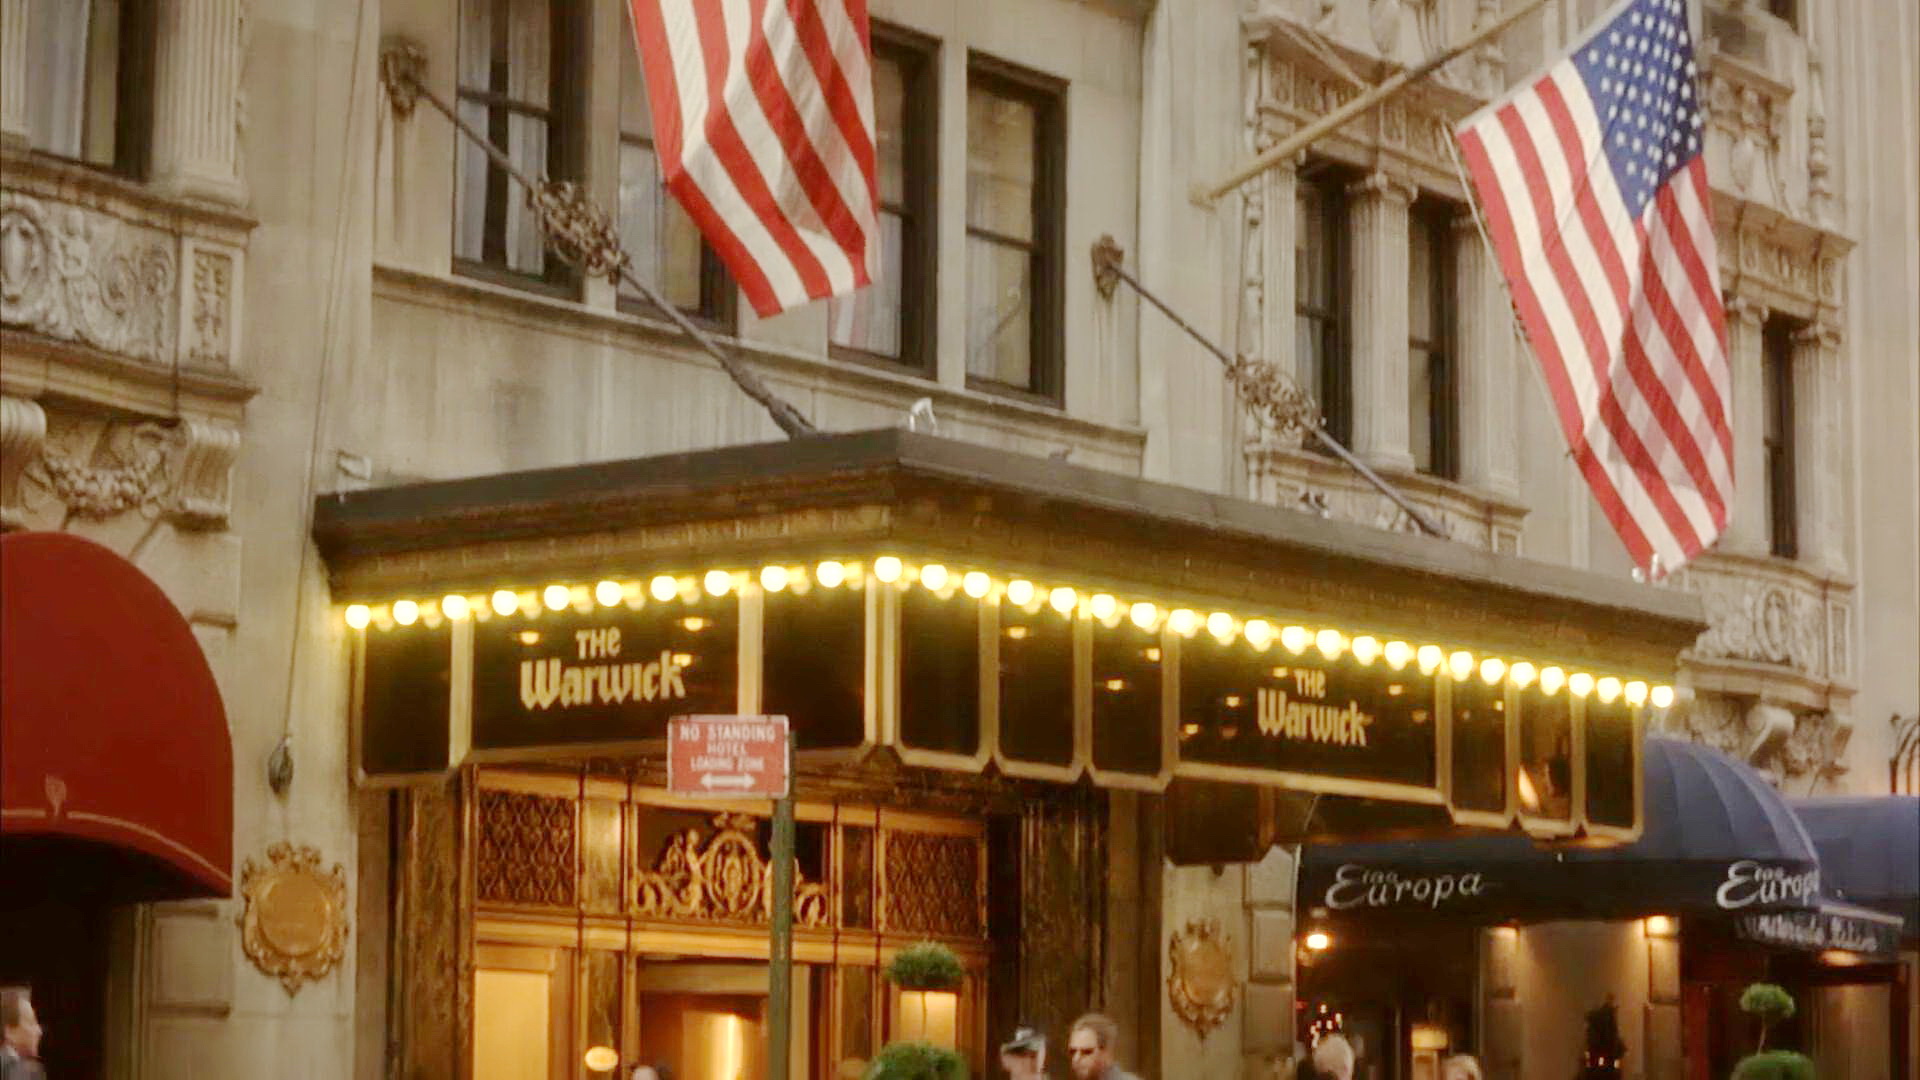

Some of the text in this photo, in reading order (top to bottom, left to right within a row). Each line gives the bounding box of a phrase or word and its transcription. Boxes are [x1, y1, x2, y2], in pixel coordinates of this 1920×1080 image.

[520, 650, 686, 710] Warwick
[681, 723, 776, 743] NO STANDING
[1257, 687, 1368, 747] Warwick
[690, 756, 765, 772] LOADING ZONE
[706, 742, 747, 757] HOTEL
[1325, 863, 1485, 910] Europa
